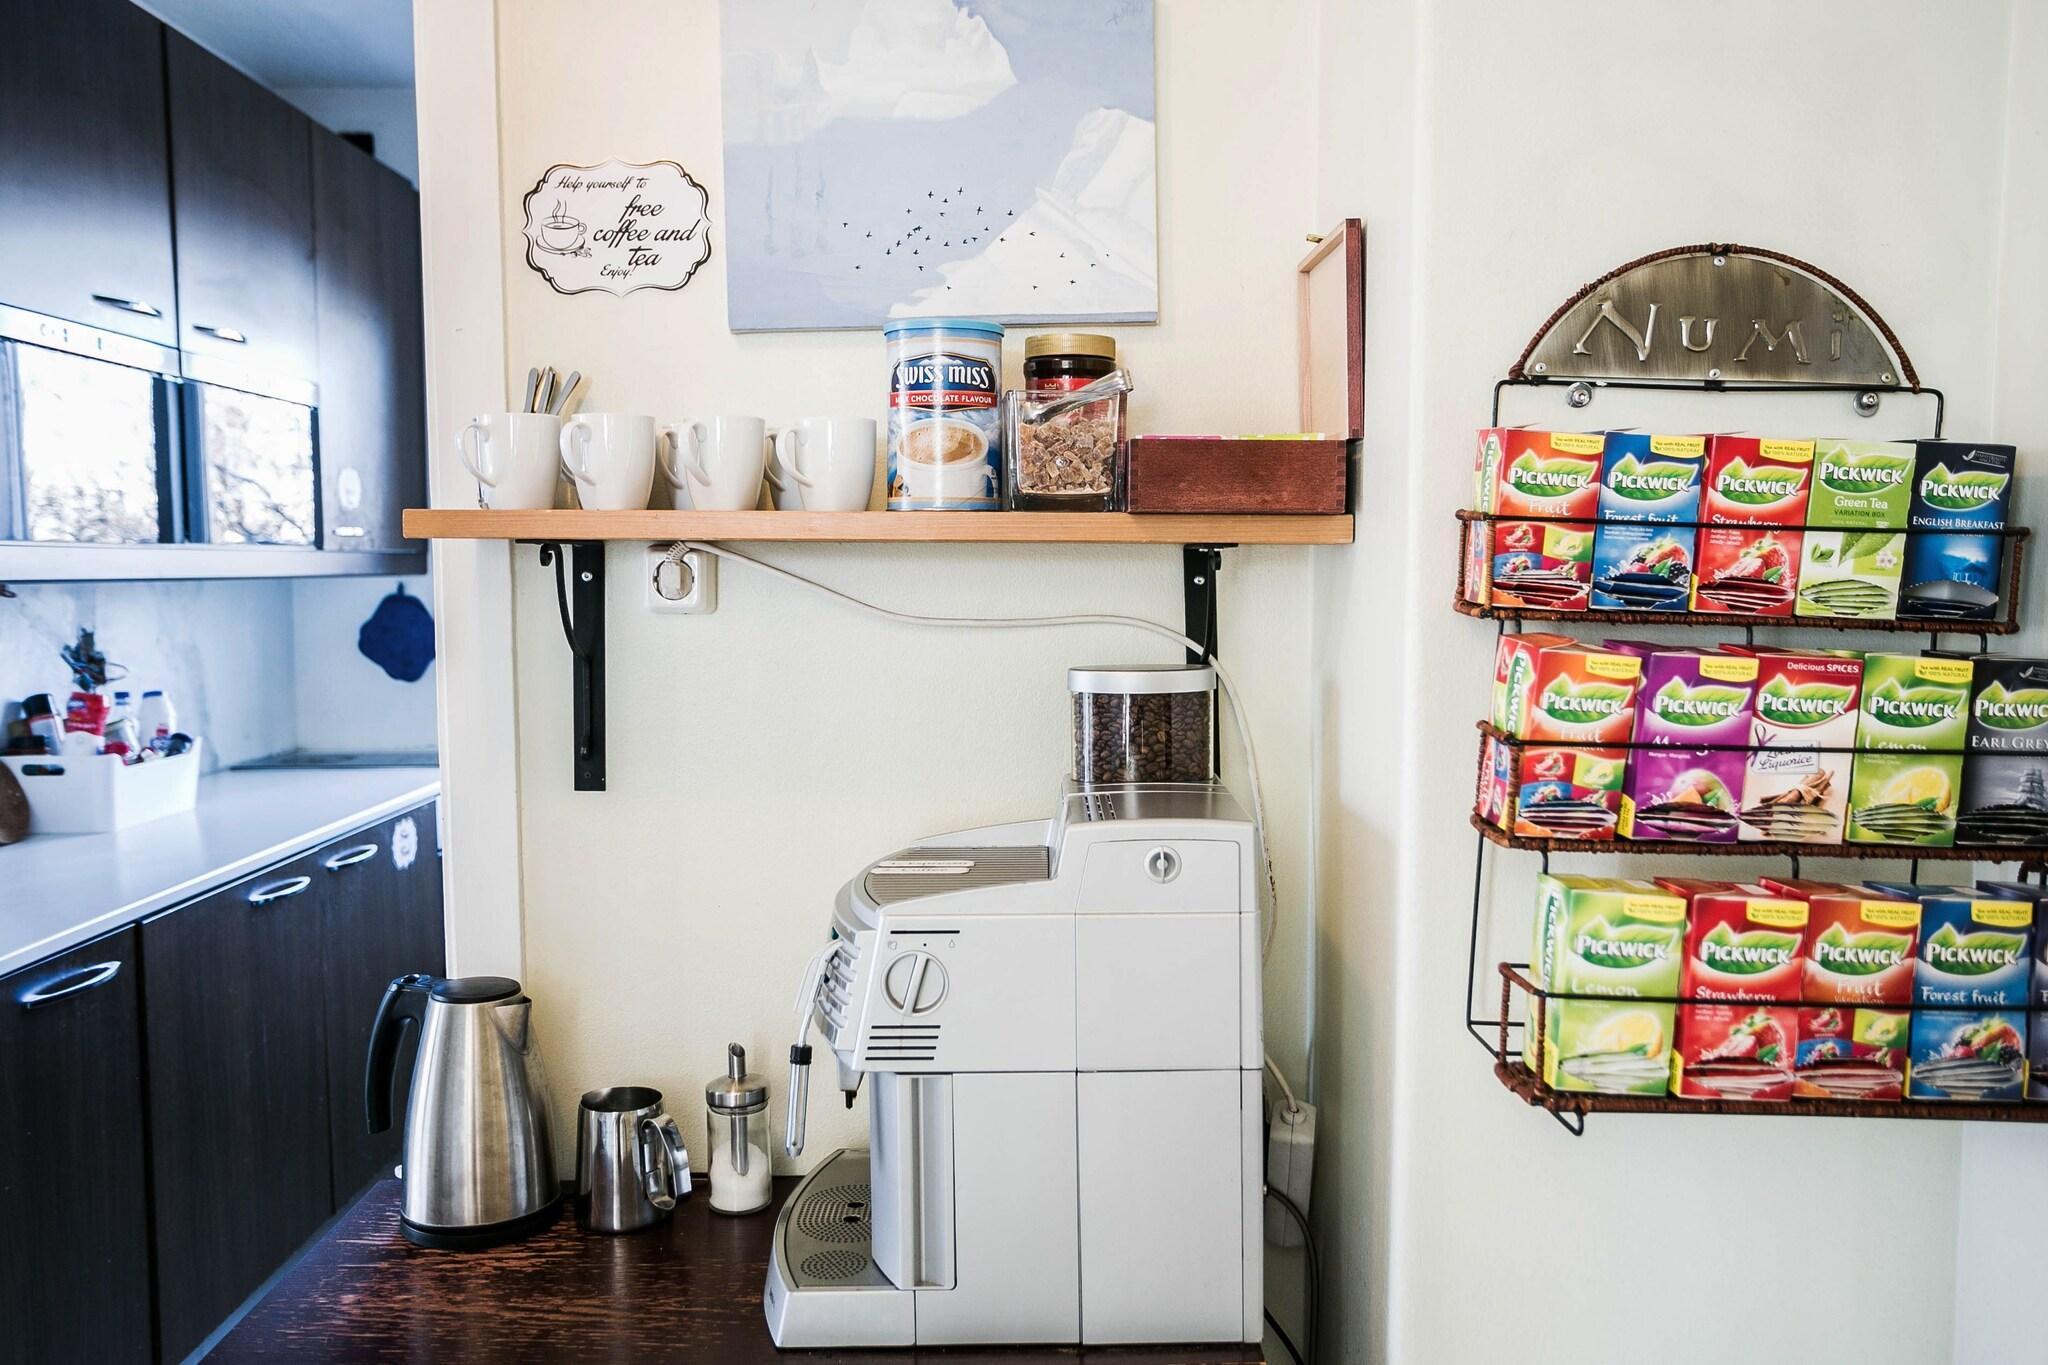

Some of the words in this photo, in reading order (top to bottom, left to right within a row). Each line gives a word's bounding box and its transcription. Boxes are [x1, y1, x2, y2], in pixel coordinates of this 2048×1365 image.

[555, 176, 583, 192] Help
[586, 176, 635, 192] yourself
[635, 177, 650, 189] to
[618, 194, 665, 223] free
[593, 219, 651, 249] coffee
[654, 219, 701, 241] and
[628, 247, 663, 266] tea
[600, 264, 638, 280] Enjoy!
[896, 362, 944, 389] SWISS
[962, 394, 992, 404] FLAVOUR
[1481, 436, 1497, 512] PICKWIC
[1510, 470, 1589, 490] PICKWICK
[1609, 470, 1689, 491] PICKWICK
[1819, 461, 1904, 484] PICKWICK
[1717, 474, 1798, 496] PICKWICK
[1920, 479, 2000, 500] PICKWICK
[1527, 499, 1573, 516] Fruit
[1834, 495, 1868, 508] Green
[1870, 497, 1888, 509] Tea
[1603, 509, 1645, 521] Forest
[1648, 512, 1679, 522] fruit
[1834, 509, 1870, 518] VARIATION
[1912, 515, 1953, 528] ENGLISH
[1955, 518, 2005, 530] BREAKFAST
[1787, 661, 1825, 672] Delicious
[1827, 662, 1859, 673] SPICES
[1506, 651, 1527, 732] PICKWIC
[1542, 692, 1624, 714] PICKWICK
[1655, 695, 1740, 717] PICKWICK
[1757, 692, 1846, 715] PICKWICK
[1870, 696, 1957, 718] PICKWICK
[1974, 699, 2048, 719] PICKWIC
[1865, 735, 1927, 749] Lemon
[1972, 735, 2008, 749] EARL
[1759, 755, 1812, 770] Liquorice
[1576, 934, 1669, 960] PICKWICK
[1701, 940, 1792, 964] PICKWICK
[1814, 942, 1902, 964] PICKWICK
[1925, 942, 2017, 964] PICKWICK
[1572, 977, 1642, 997] Lemon
[1695, 985, 1776, 1003] Strawberry
[1921, 985, 1968, 1002] Forest
[1972, 989, 2007, 1005] fruit
